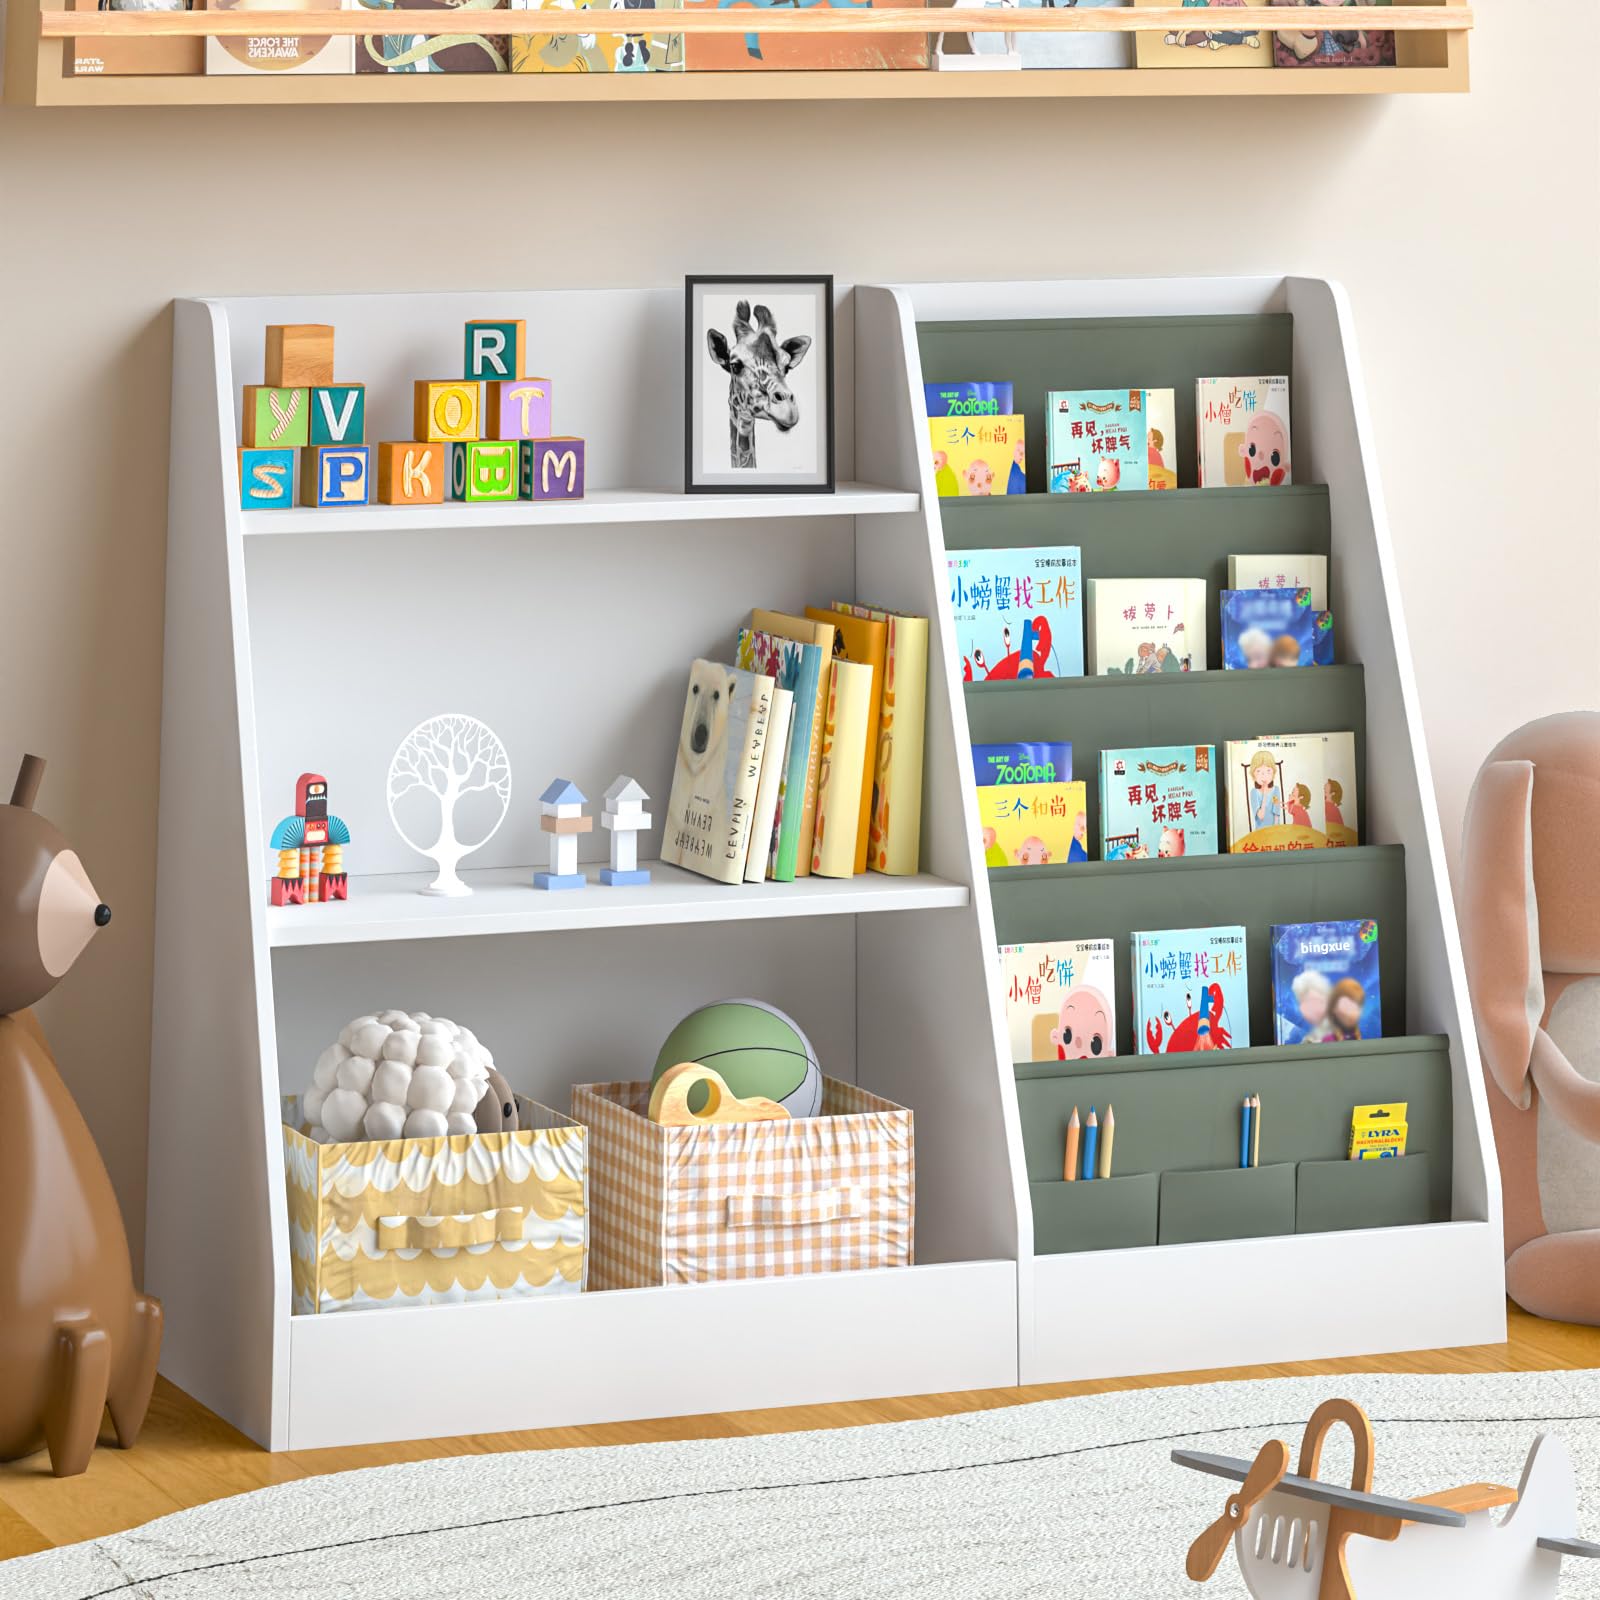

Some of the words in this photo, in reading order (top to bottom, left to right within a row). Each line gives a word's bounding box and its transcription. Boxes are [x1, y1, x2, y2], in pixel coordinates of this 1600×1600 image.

[472, 328, 509, 376] R
[318, 390, 358, 441] V
[433, 388, 473, 436] O
[508, 387, 545, 436] T
[946, 397, 1000, 416] ZOOTOPIA
[946, 425, 1008, 446] 三个和尚
[1091, 435, 1131, 454] 坏脾气
[249, 464, 286, 499] S
[325, 456, 363, 498] P
[403, 450, 432, 498] K
[542, 449, 577, 492] M
[951, 574, 1076, 611] 小螃蟹找工作
[1122, 602, 1175, 621] 拔萝卜
[995, 762, 1056, 785] ZOOTOPIA
[995, 795, 1066, 821] 三个和尚
[1152, 799, 1197, 824] 坏脾气
[1145, 949, 1242, 980] 小螃蟹找工作
[1300, 941, 1351, 955] bingxue
[1009, 954, 1074, 1005] 小僧吃饼
[1368, 1129, 1400, 1138] LYRA
